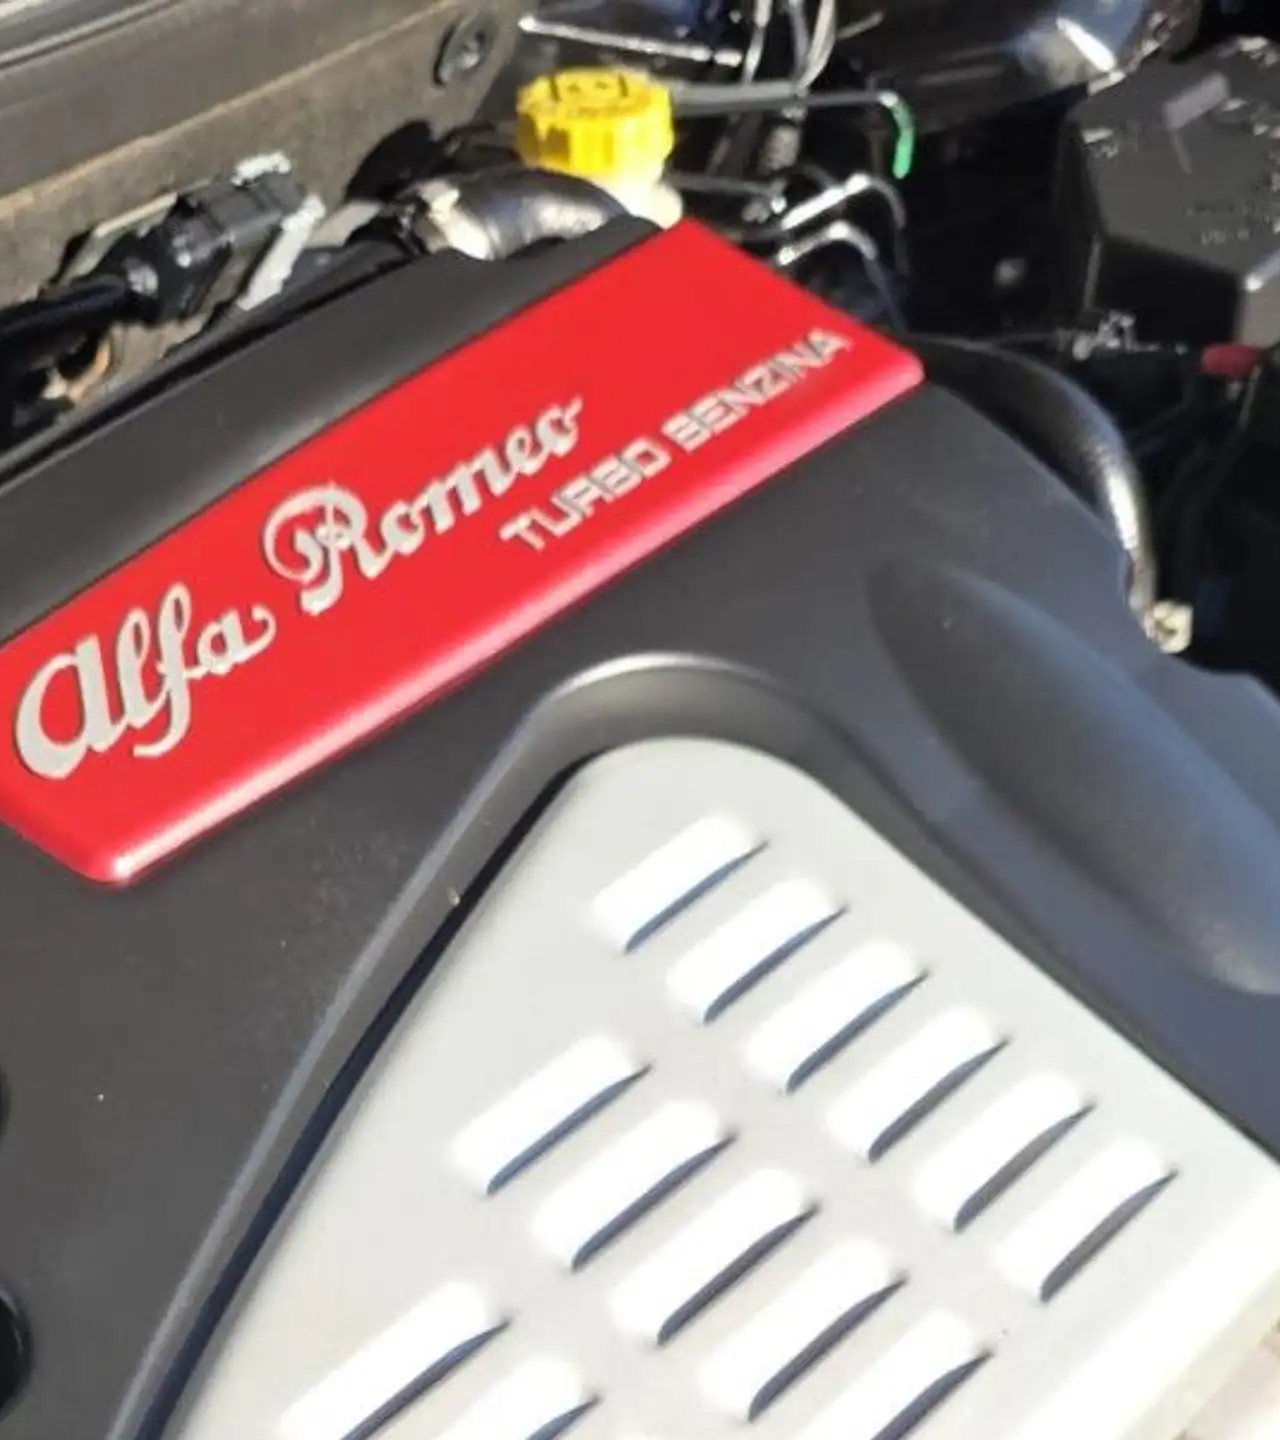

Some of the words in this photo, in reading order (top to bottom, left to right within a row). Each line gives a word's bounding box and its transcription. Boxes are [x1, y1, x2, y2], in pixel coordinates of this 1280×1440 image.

[14, 582, 277, 779] Alfa
[261, 395, 582, 615] Romeo
[499, 436, 672, 551] TURBO
[660, 326, 854, 454] BENZINA
